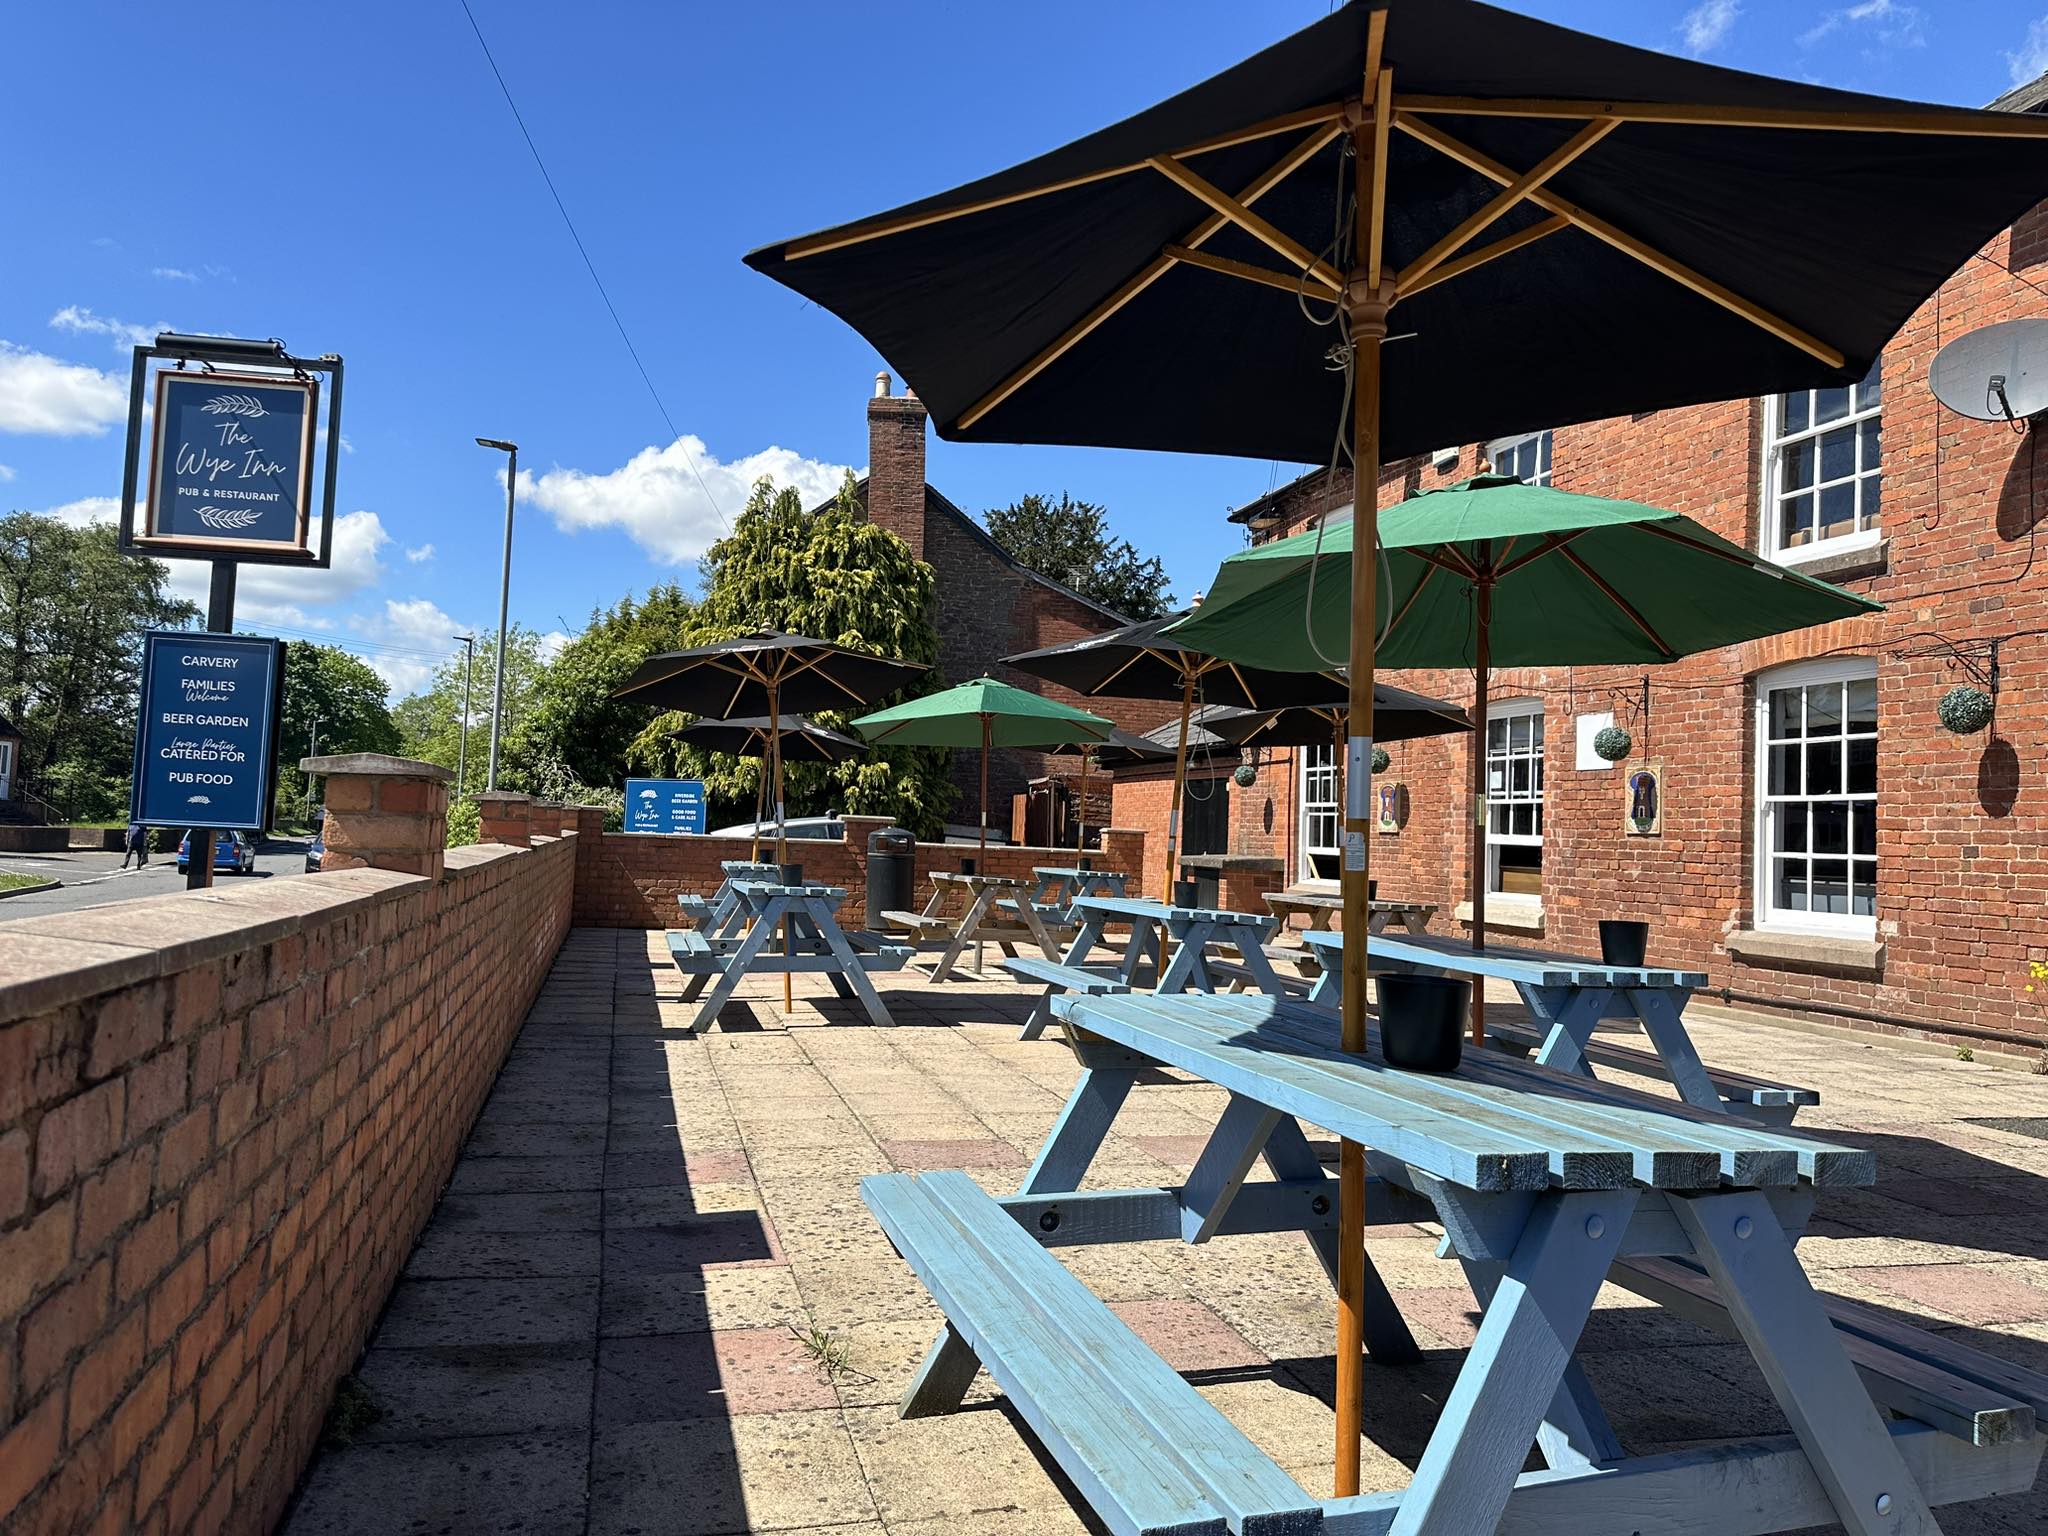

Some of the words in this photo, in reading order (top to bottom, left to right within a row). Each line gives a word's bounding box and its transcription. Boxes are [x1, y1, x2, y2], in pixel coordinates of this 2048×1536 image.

[215, 421, 253, 446] The
[176, 442, 235, 481] Wye
[238, 449, 287, 478] Inn
[178, 487, 199, 496] PUB
[214, 490, 279, 502] RESTAURANT
[182, 655, 239, 668] CARVERY
[181, 679, 235, 691] FAMILIES
[186, 690, 229, 702] Welcome
[163, 713, 193, 724] BEER
[196, 715, 249, 727] GARDEN
[171, 737, 198, 749] Large
[201, 739, 236, 751] Parties
[161, 748, 217, 761] CATERED
[220, 751, 244, 762] FOR
[169, 773, 193, 783] PUB
[196, 773, 233, 785] FOOD
[643, 801, 653, 809] The
[635, 810, 648, 821] Wye
[648, 810, 660, 820] Inn
